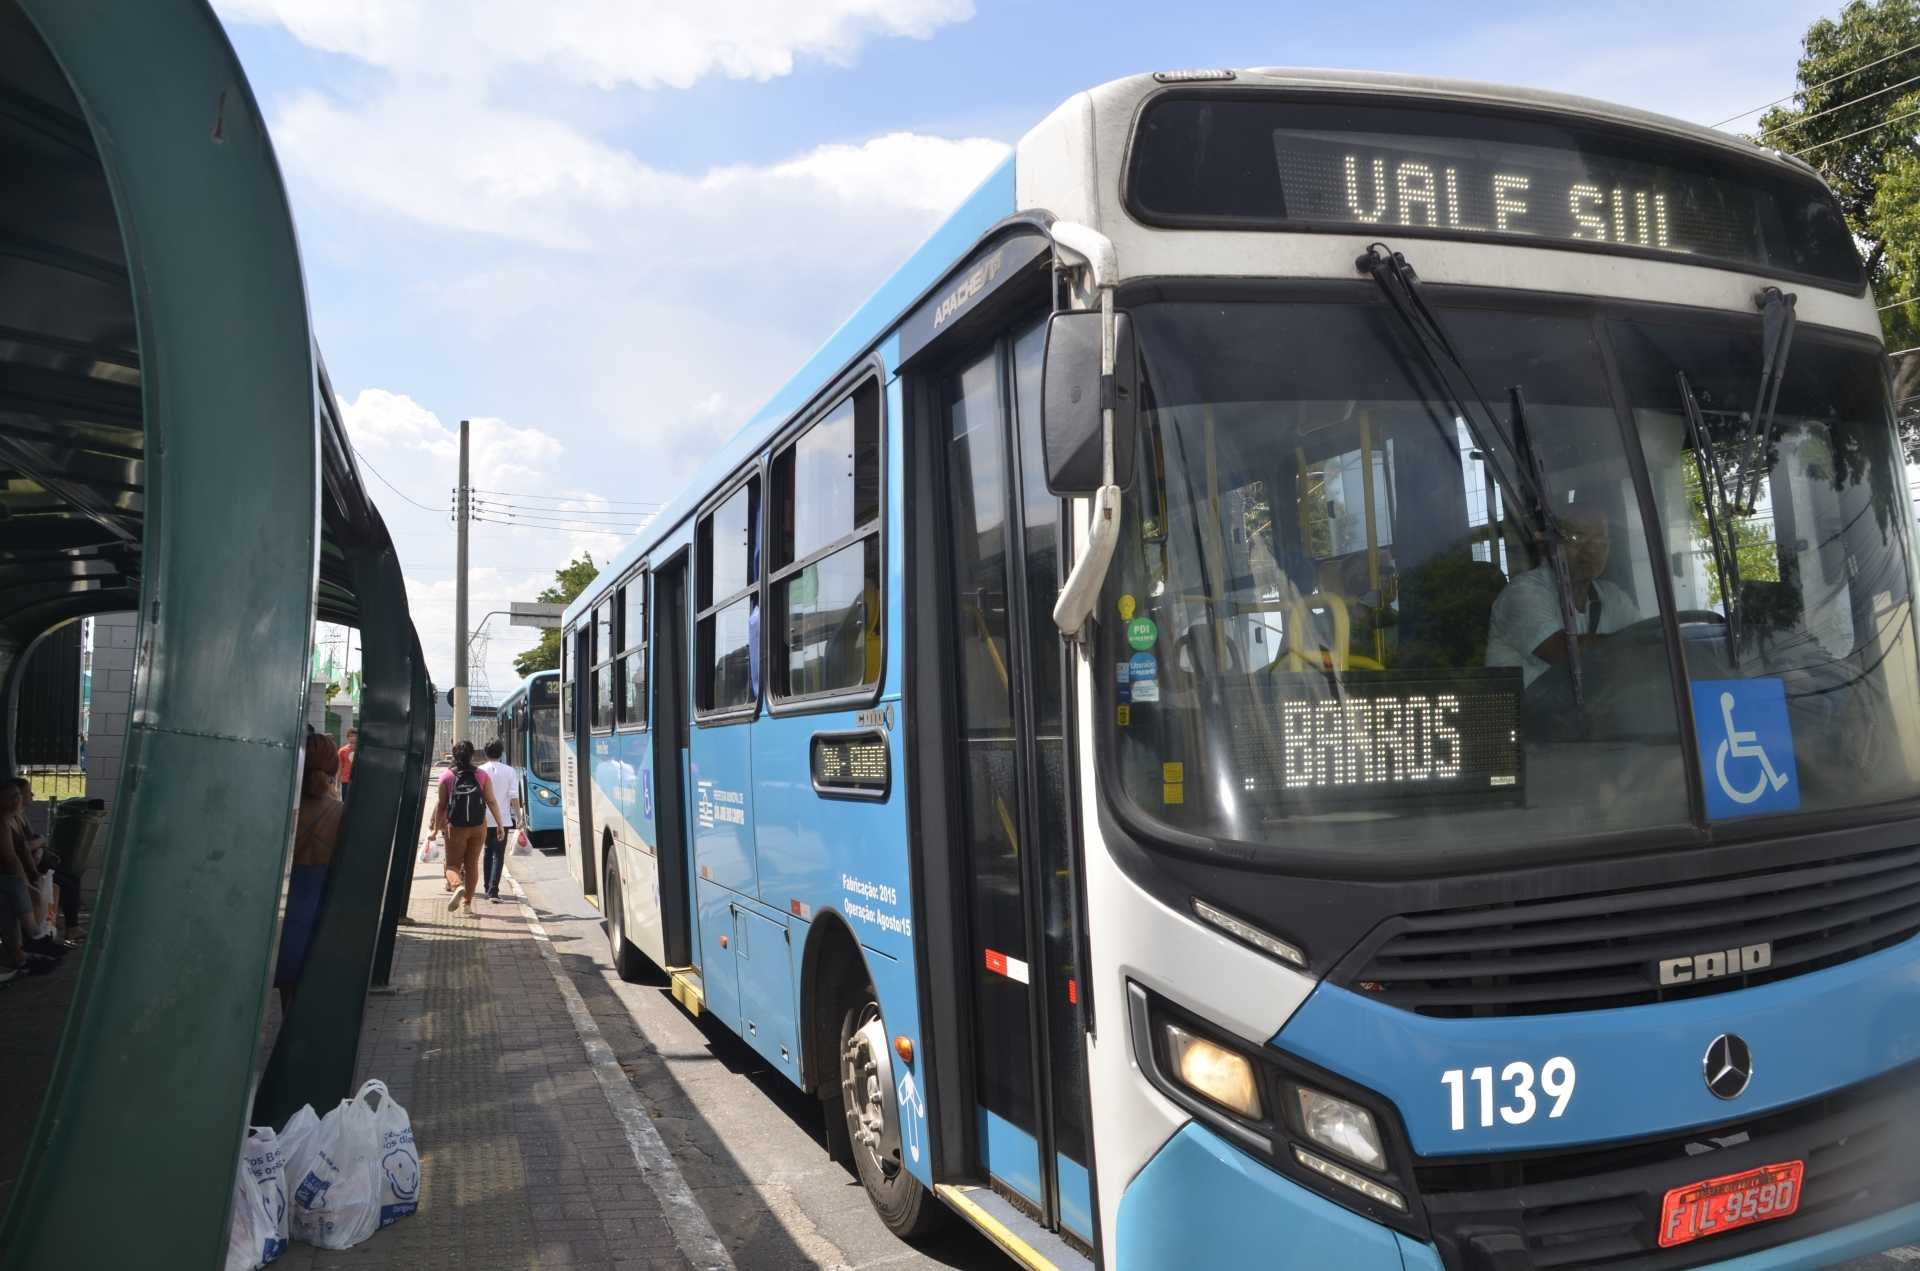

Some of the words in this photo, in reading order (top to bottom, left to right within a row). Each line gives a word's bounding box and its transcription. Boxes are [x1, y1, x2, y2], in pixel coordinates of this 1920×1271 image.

[1284, 695, 1460, 787] BARROS
[879, 884, 896, 906] 2015
[1659, 942, 1772, 985] CAIO
[1441, 1056, 1576, 1131] 1139
